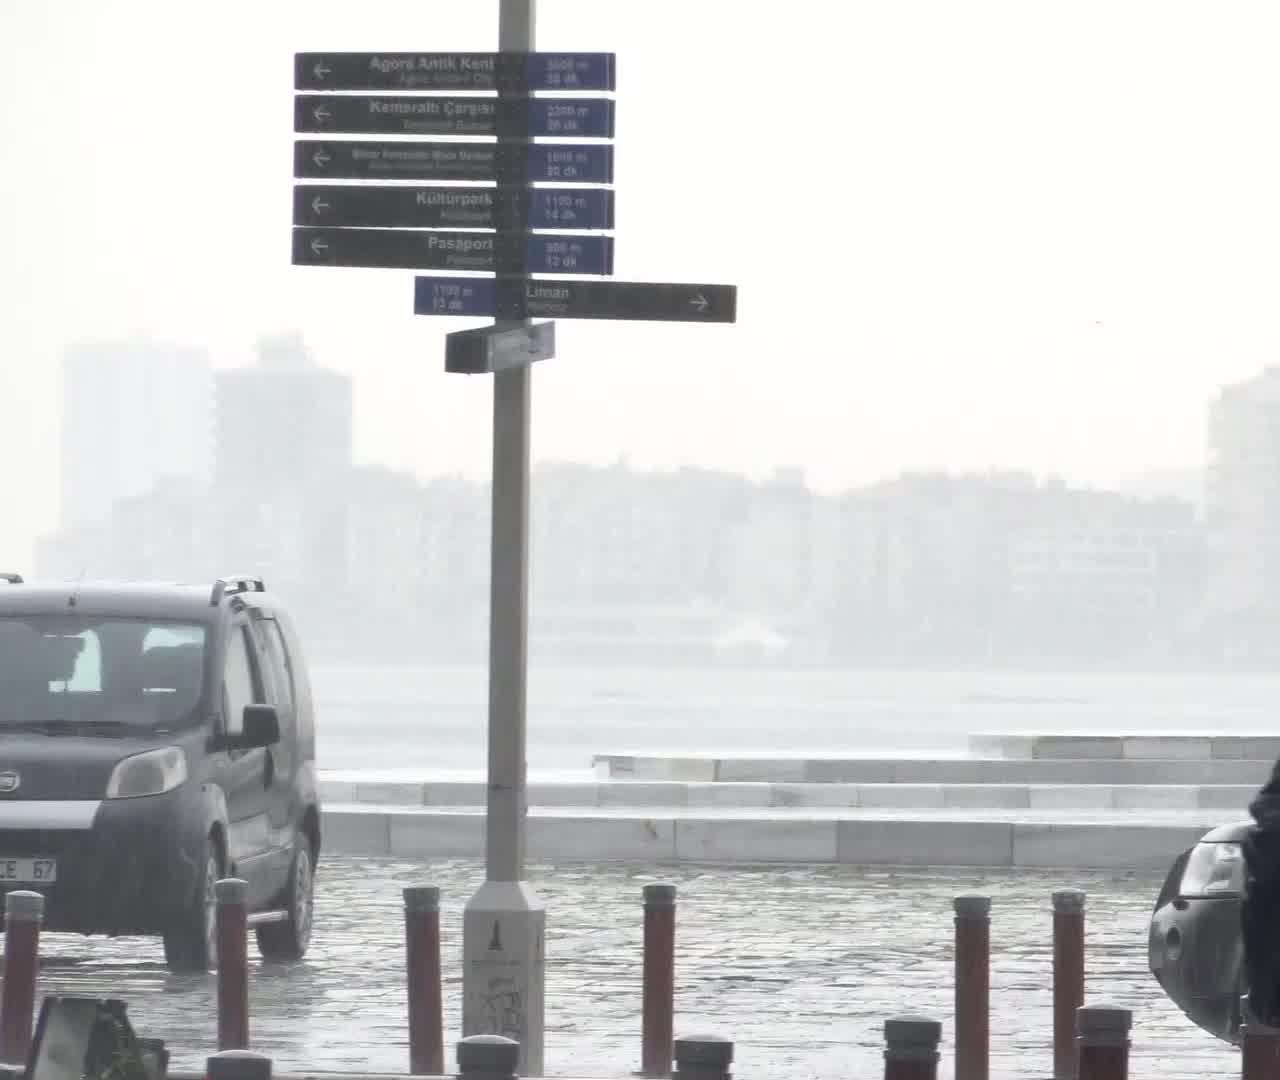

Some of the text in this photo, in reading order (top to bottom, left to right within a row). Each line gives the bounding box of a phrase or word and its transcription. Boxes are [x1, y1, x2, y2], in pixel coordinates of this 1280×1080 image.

[369, 56, 414, 73] Agora
[418, 56, 455, 70] Antik
[416, 191, 493, 207] Kültürpark
[428, 235, 493, 252] Pasaport
[33, 861, 54, 879] 67
